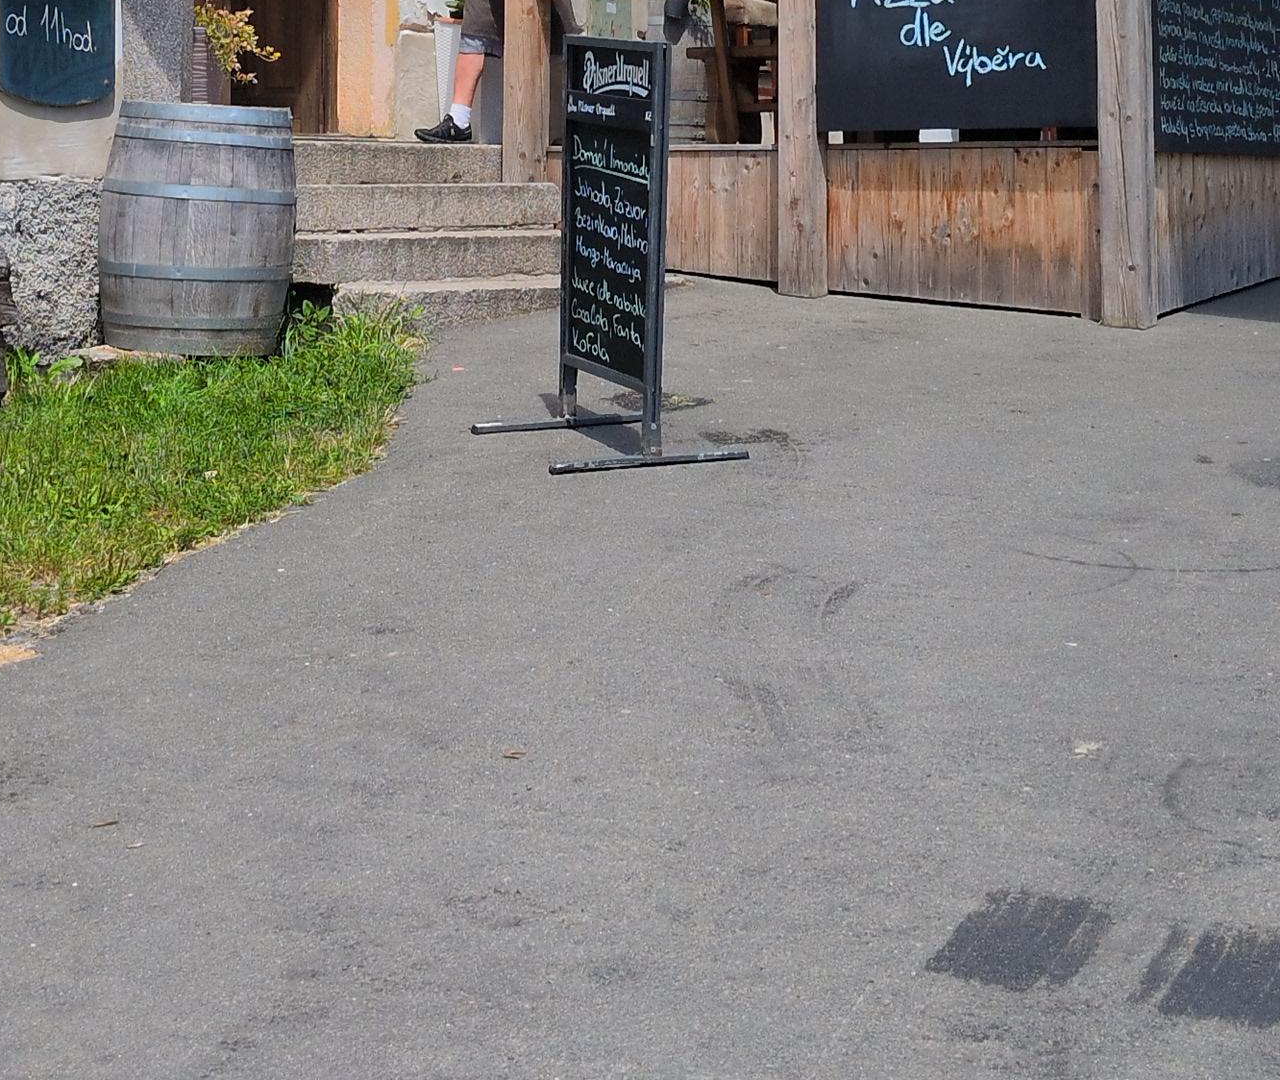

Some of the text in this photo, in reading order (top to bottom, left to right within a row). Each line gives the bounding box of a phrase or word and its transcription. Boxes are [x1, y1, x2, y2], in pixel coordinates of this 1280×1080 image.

[5, 4, 27, 36] od
[899, 6, 952, 47] dle
[582, 50, 617, 94] Pilsner
[572, 133, 608, 169] Domácí
